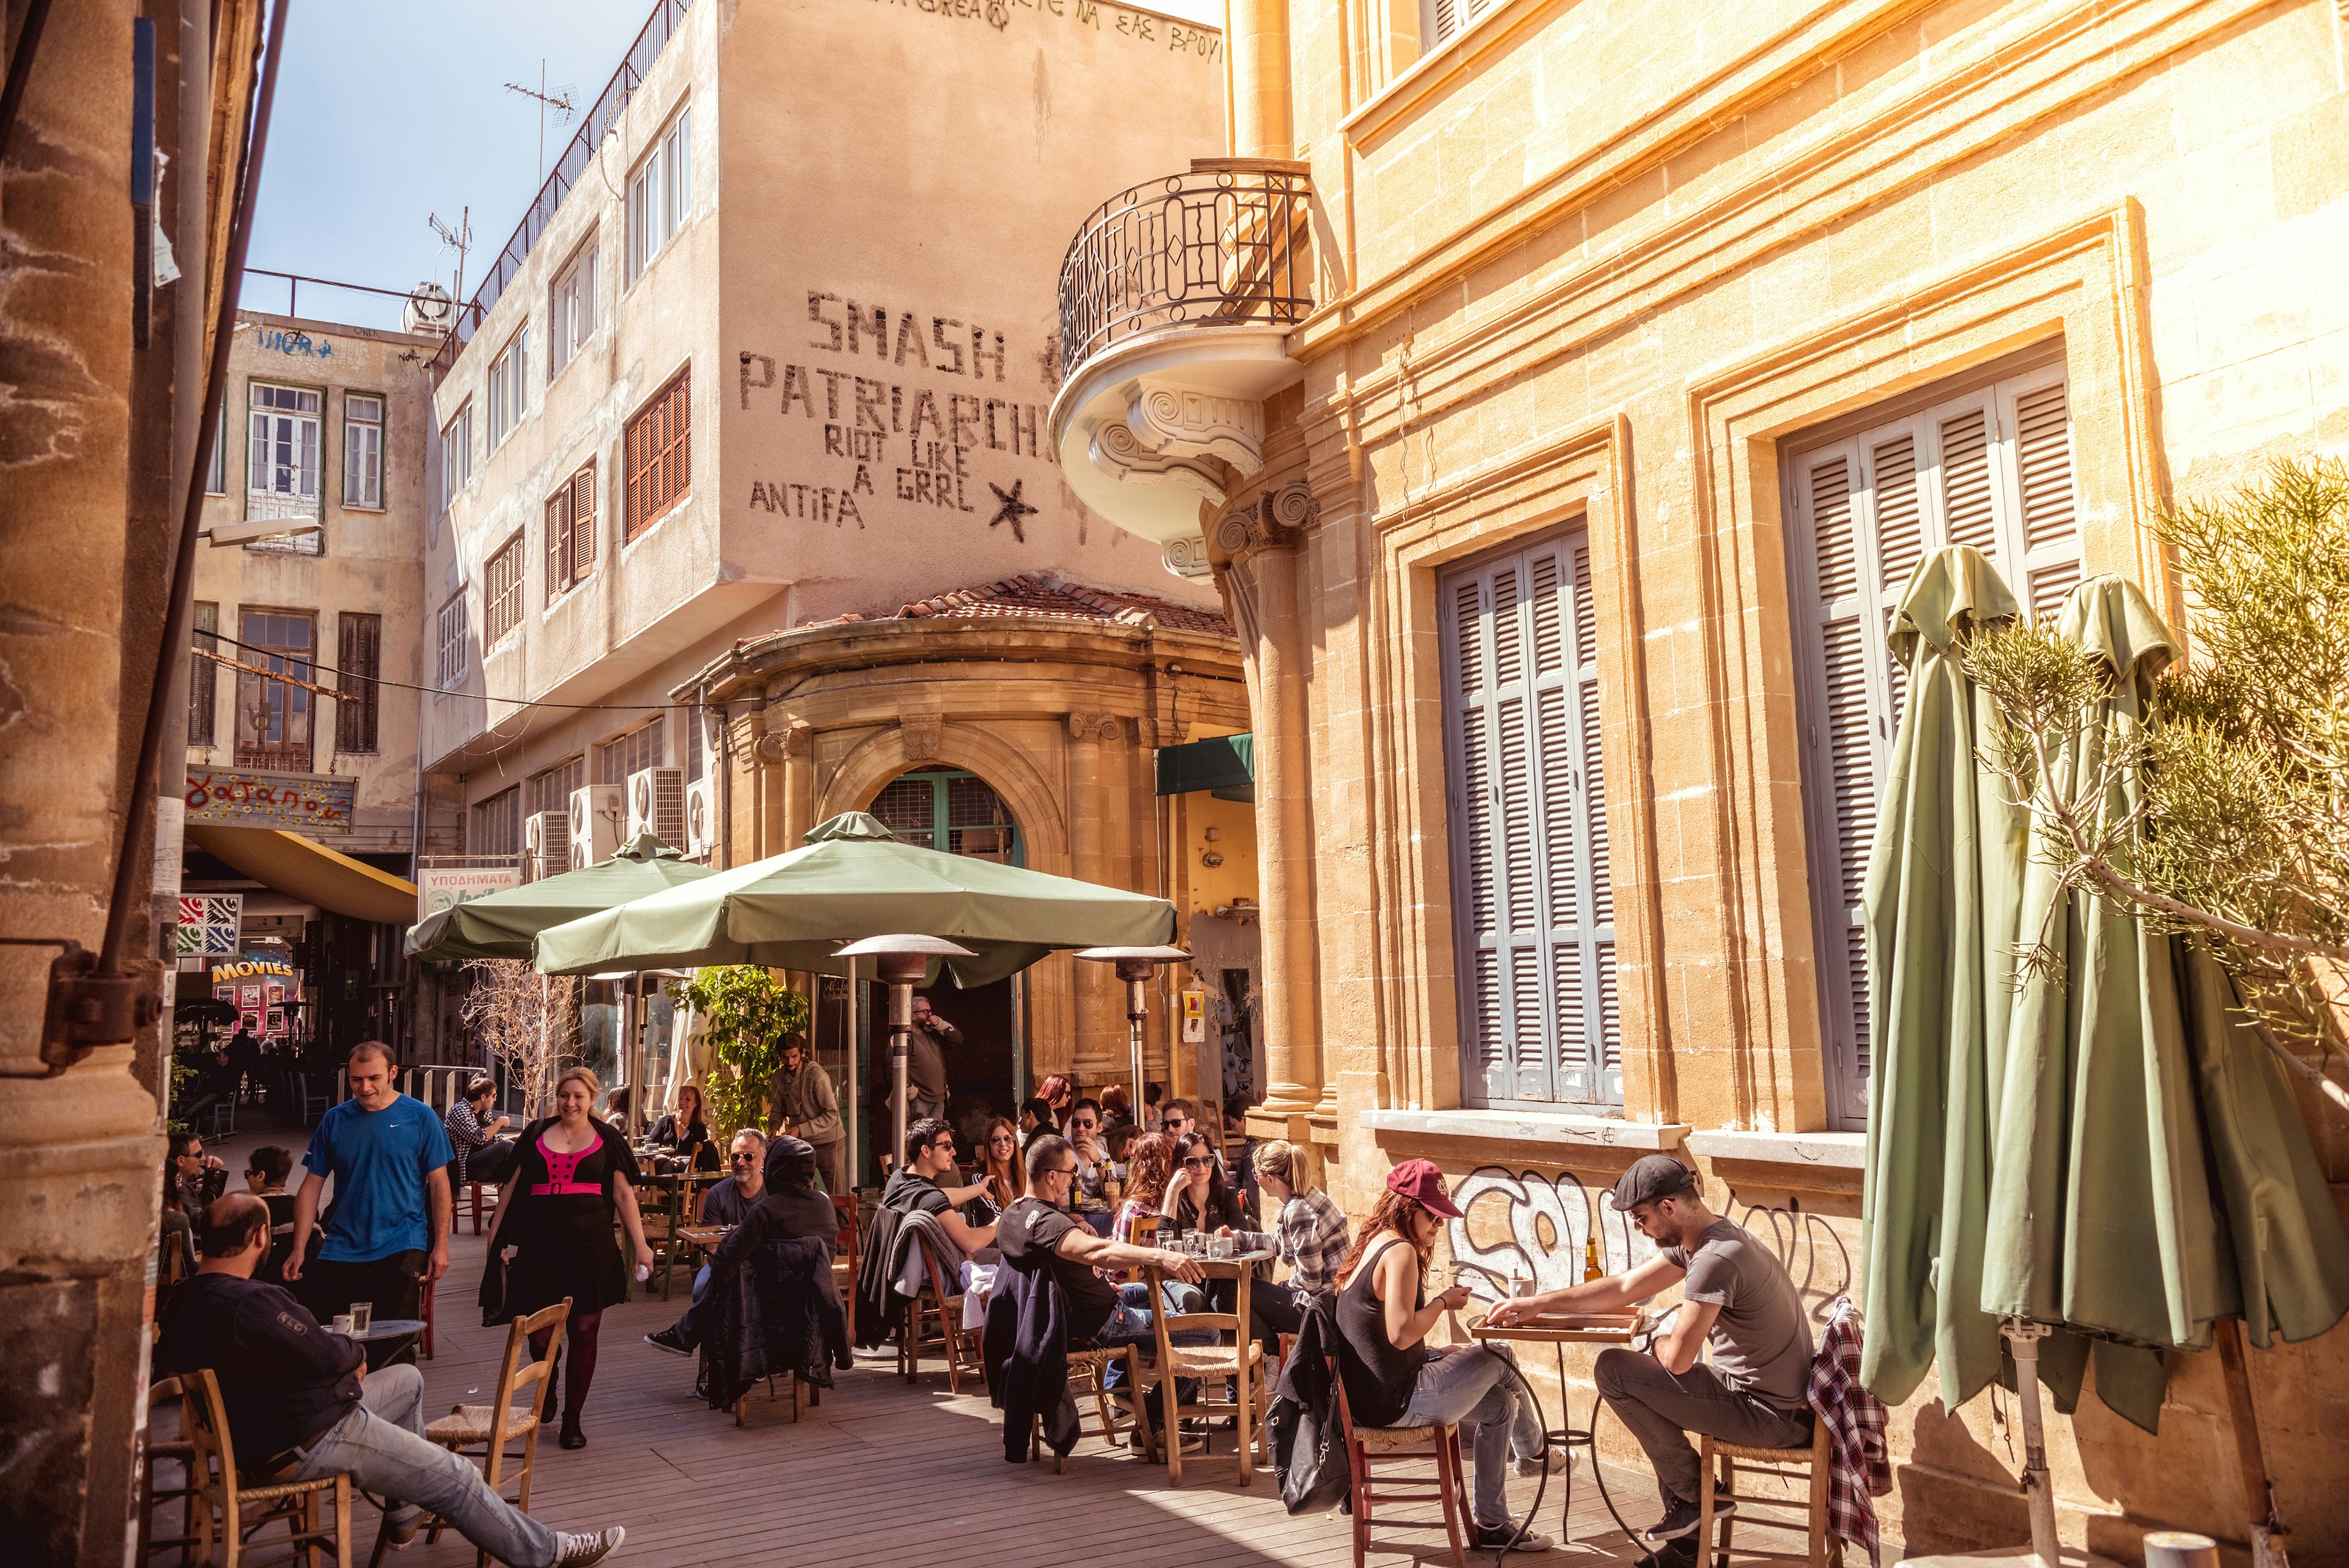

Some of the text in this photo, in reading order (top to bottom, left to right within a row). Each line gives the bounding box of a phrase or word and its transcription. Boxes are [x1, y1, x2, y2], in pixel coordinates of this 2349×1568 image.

[807, 289, 1006, 382] SMASH
[825, 424, 971, 478] RIOT LIKE
[853, 464, 974, 513] A GRRL
[431, 874, 512, 886] ΥΠΟΔΗΜΑΤΑ
[212, 961, 293, 983] MOVIES
